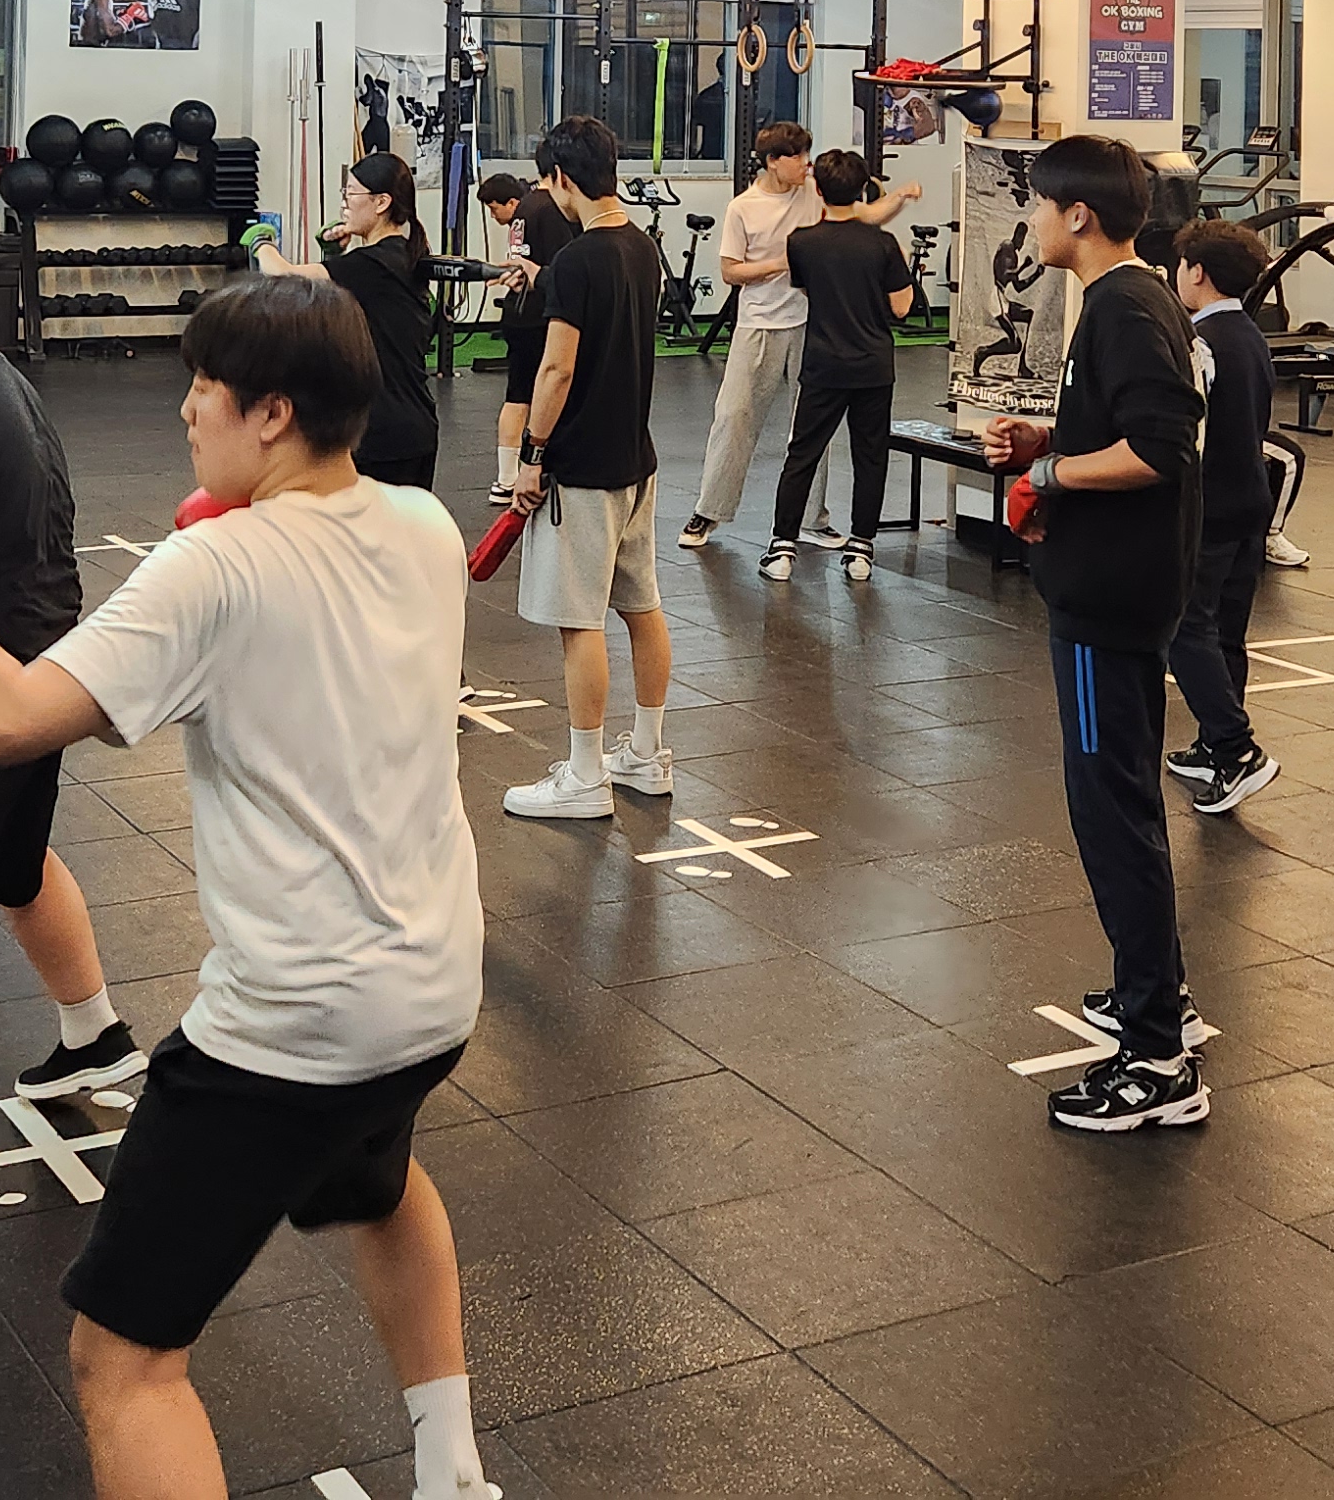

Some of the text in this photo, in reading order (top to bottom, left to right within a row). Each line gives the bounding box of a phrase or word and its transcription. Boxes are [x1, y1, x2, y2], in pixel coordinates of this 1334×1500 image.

[1101, 5, 1163, 18] OK BOXING
[1120, 20, 1145, 31] GYM
[1097, 51, 1116, 62] THE
[1118, 51, 1134, 62] OK
